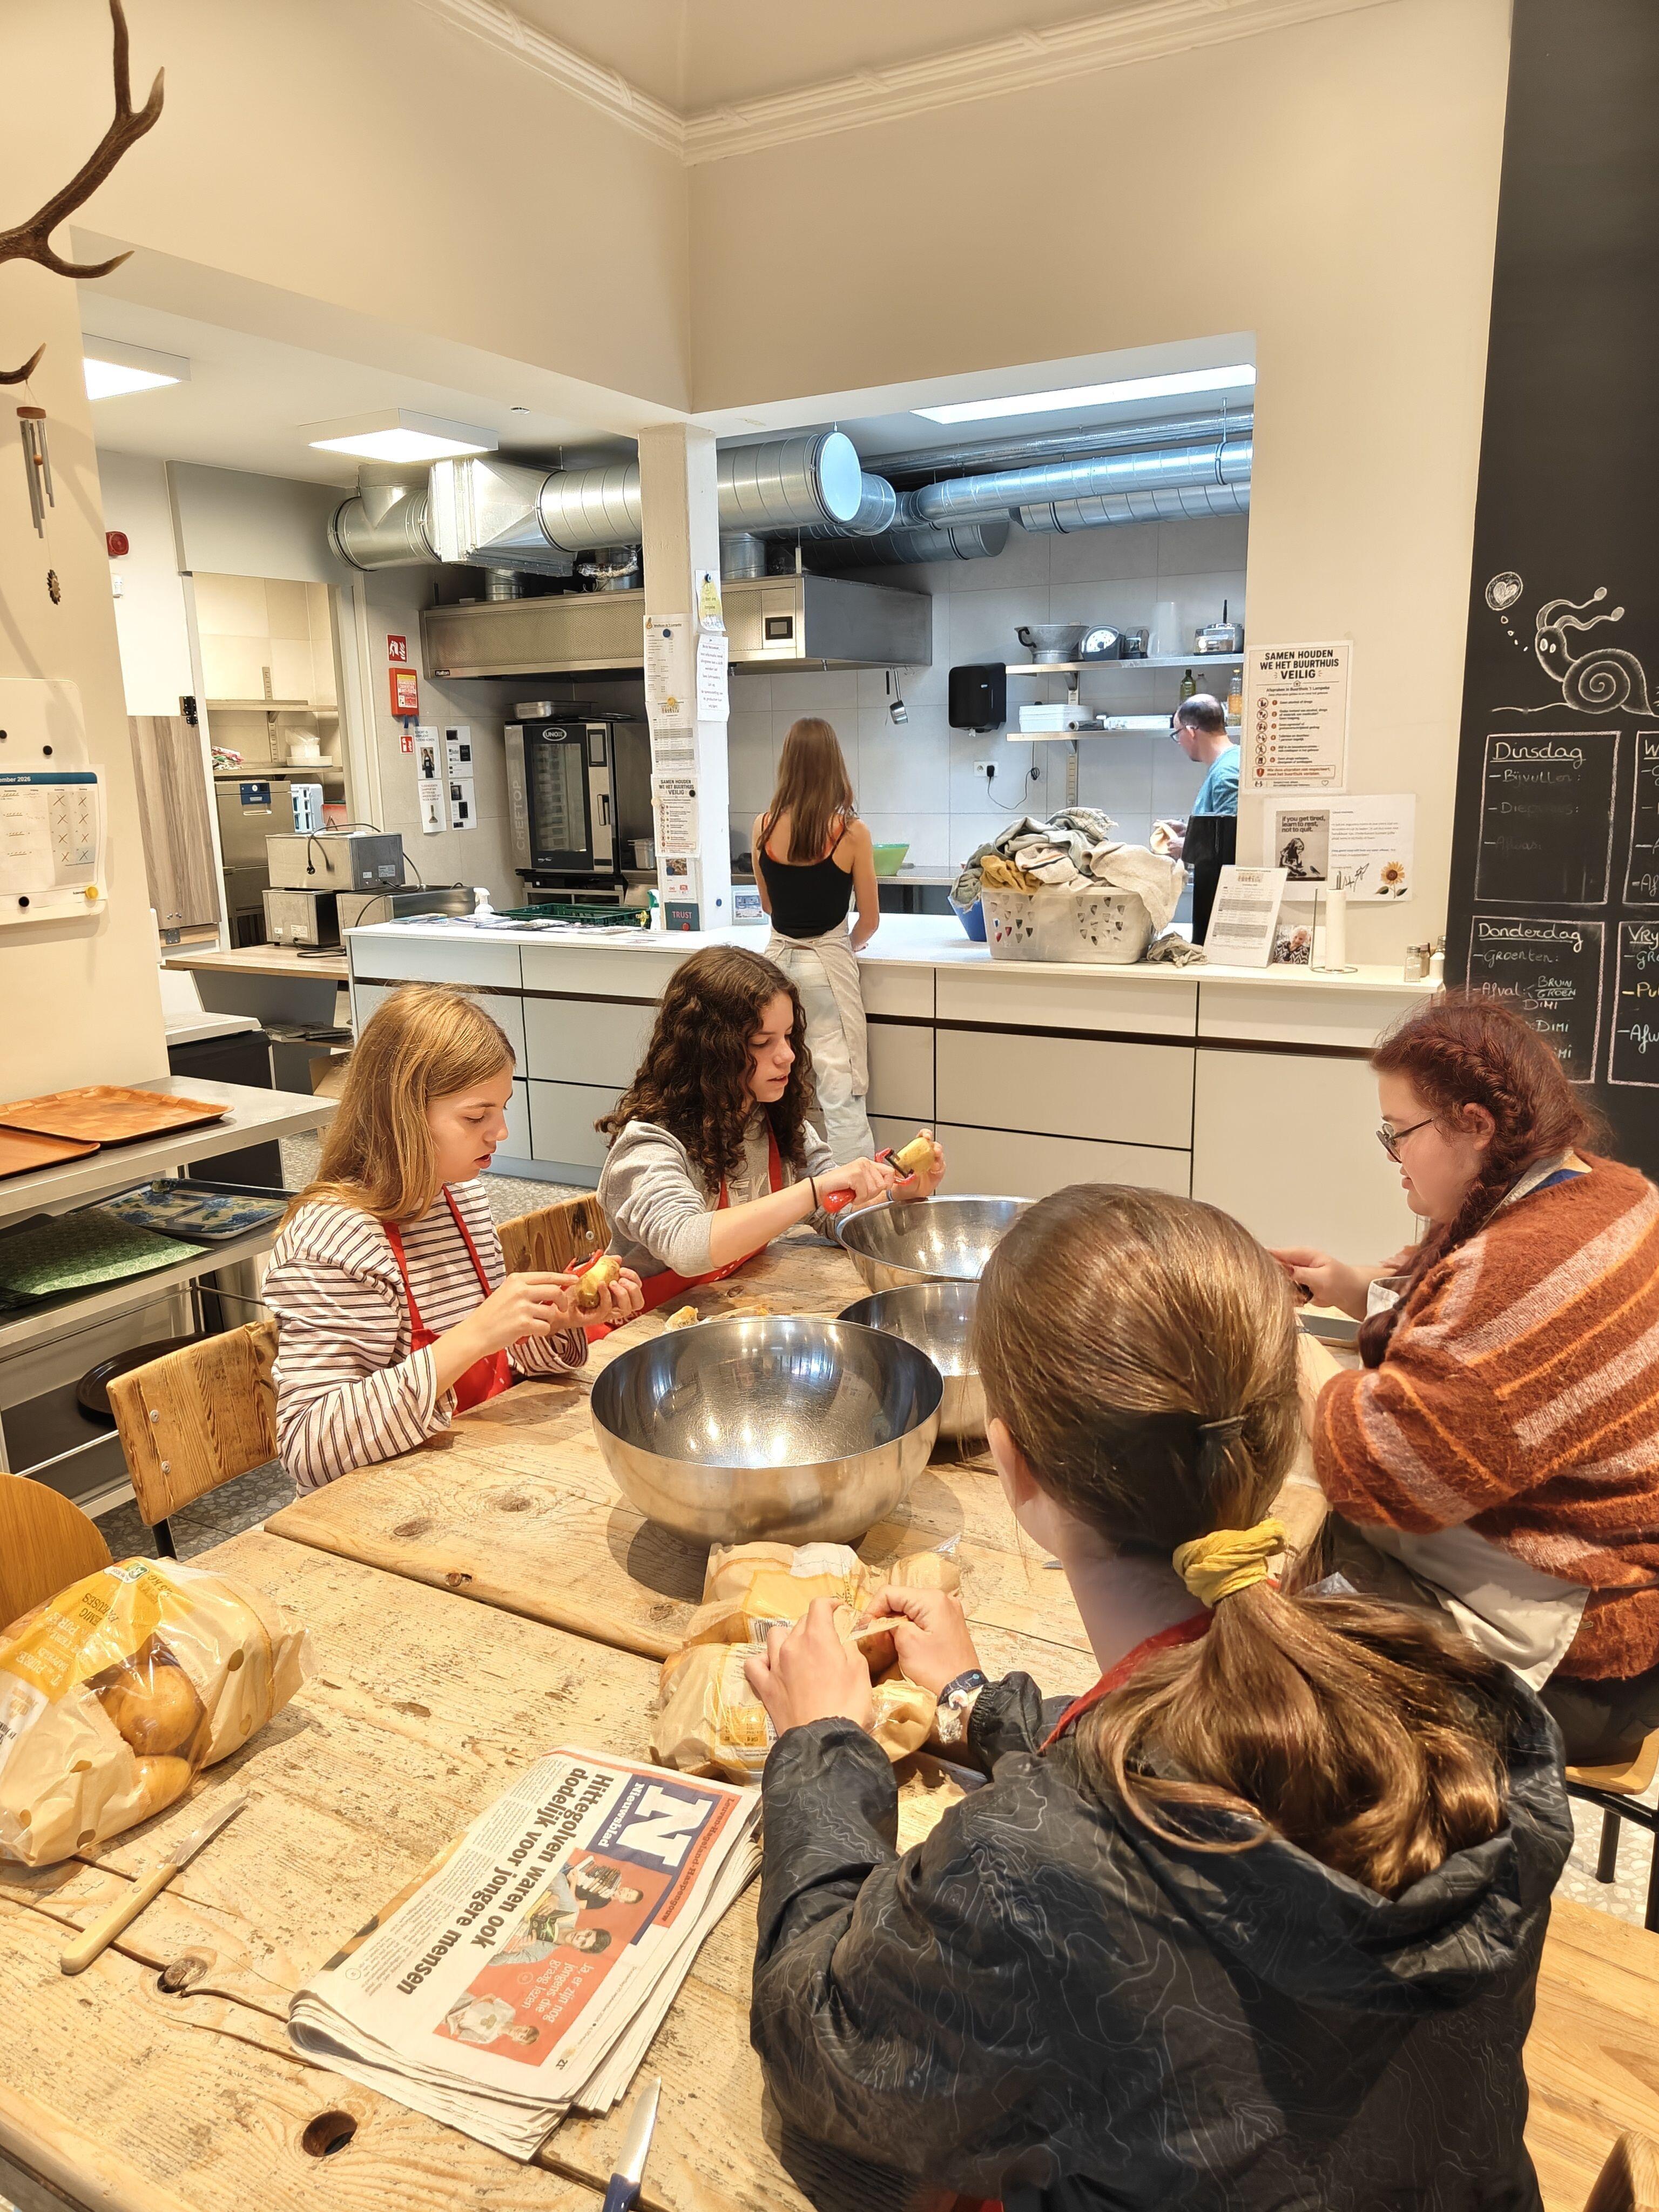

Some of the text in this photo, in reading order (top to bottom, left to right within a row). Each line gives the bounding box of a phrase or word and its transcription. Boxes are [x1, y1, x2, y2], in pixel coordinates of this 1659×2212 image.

[1260, 658, 1339, 670] WE HET BUURTHUIS
[1265, 649, 1333, 660] SAMEN HOUDEN
[1280, 669, 1316, 679] VEILIG
[1493, 741, 1583, 769] Dinsdag
[513, 781, 525, 851] CHEFTOP
[672, 911, 692, 919] TRUST
[1478, 922, 1583, 953] Donderdag
[533, 1768, 586, 1828] dodelijk
[537, 1773, 614, 1863] Hittegolven
[597, 1783, 645, 1846] Nieuwsblad
[507, 1832, 542, 1867] voor
[615, 1785, 713, 1866] N
[660, 1798, 734, 1921] Leuven-Hageland-Haspengouw
[455, 1867, 516, 1928] jongere
[498, 1866, 546, 1913] waren
[470, 1914, 505, 1949] ook
[394, 1929, 462, 1997] mensen
[520, 1958, 562, 2009] graag lezen
[534, 1962, 578, 2013] jongens die
[542, 1963, 594, 2023] Ja, er zijn nog
